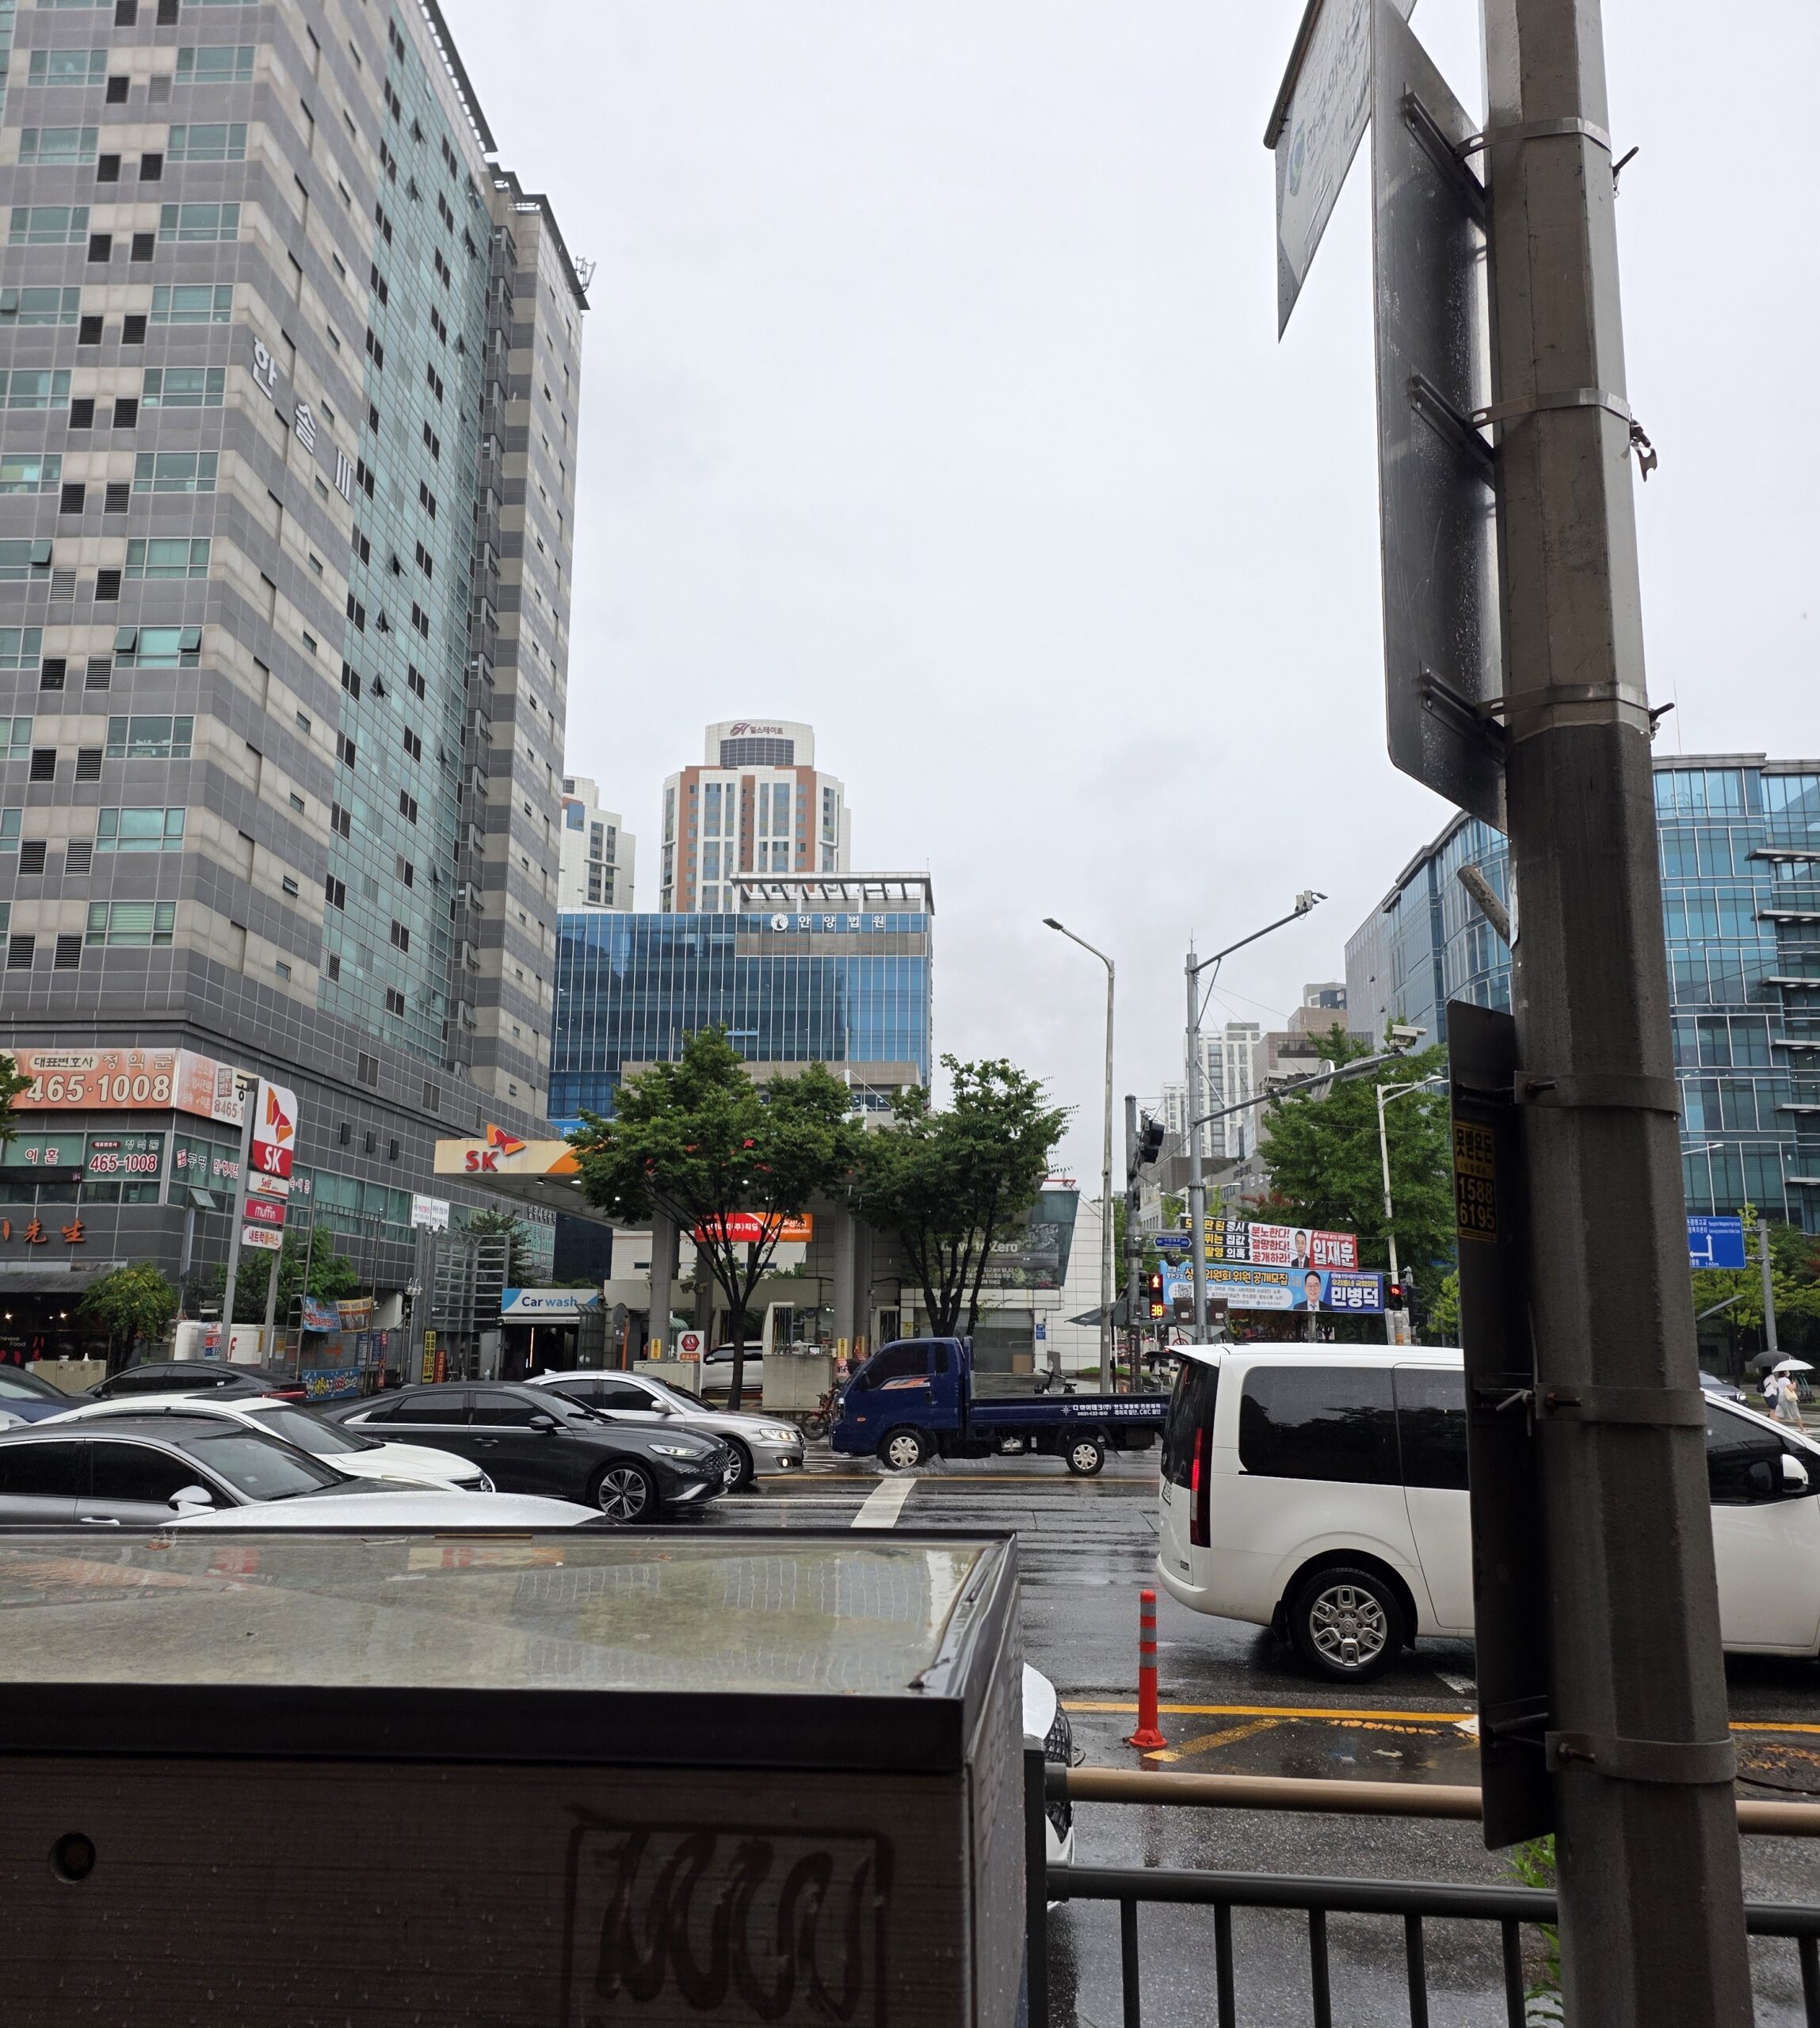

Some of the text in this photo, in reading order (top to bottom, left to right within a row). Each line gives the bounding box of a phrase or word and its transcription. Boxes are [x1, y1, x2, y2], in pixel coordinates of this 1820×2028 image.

[750, 726, 784, 734] 힐스테이트
[798, 915, 885, 928] 안양법원
[34, 1057, 94, 1068] 대표변호사
[25, 1148, 59, 1165] 이혼
[89, 1153, 158, 1172] 465-1008
[188, 1153, 208, 1172] 공평
[264, 1146, 283, 1173] SK
[465, 1150, 498, 1172] SK
[261, 1177, 273, 1189] Self
[1459, 1176, 1494, 1205] 1588
[254, 1205, 276, 1220] muffin
[1459, 1202, 1496, 1230] 6195
[248, 1229, 280, 1246] 내트럭플러스
[1215, 1220, 1225, 1231] 된
[1226, 1222, 1245, 1233] 증시
[1251, 1226, 1291, 1239] 분노한다!
[990, 1240, 1018, 1252] Zero
[1226, 1235, 1245, 1246] 집값
[1251, 1238, 1291, 1251] 절망한다!
[1226, 1248, 1246, 1259] 의혹
[1252, 1251, 1291, 1264] 공개하라!
[1313, 1239, 1355, 1268] 임재훈
[1185, 1267, 1231, 1282] 상위원회
[1232, 1270, 1252, 1284] 위원
[1253, 1271, 1288, 1286] 공개모집
[521, 1295, 578, 1307] Car wash
[1331, 1287, 1379, 1308] 민병덕
[1151, 1304, 1163, 1317] 38
